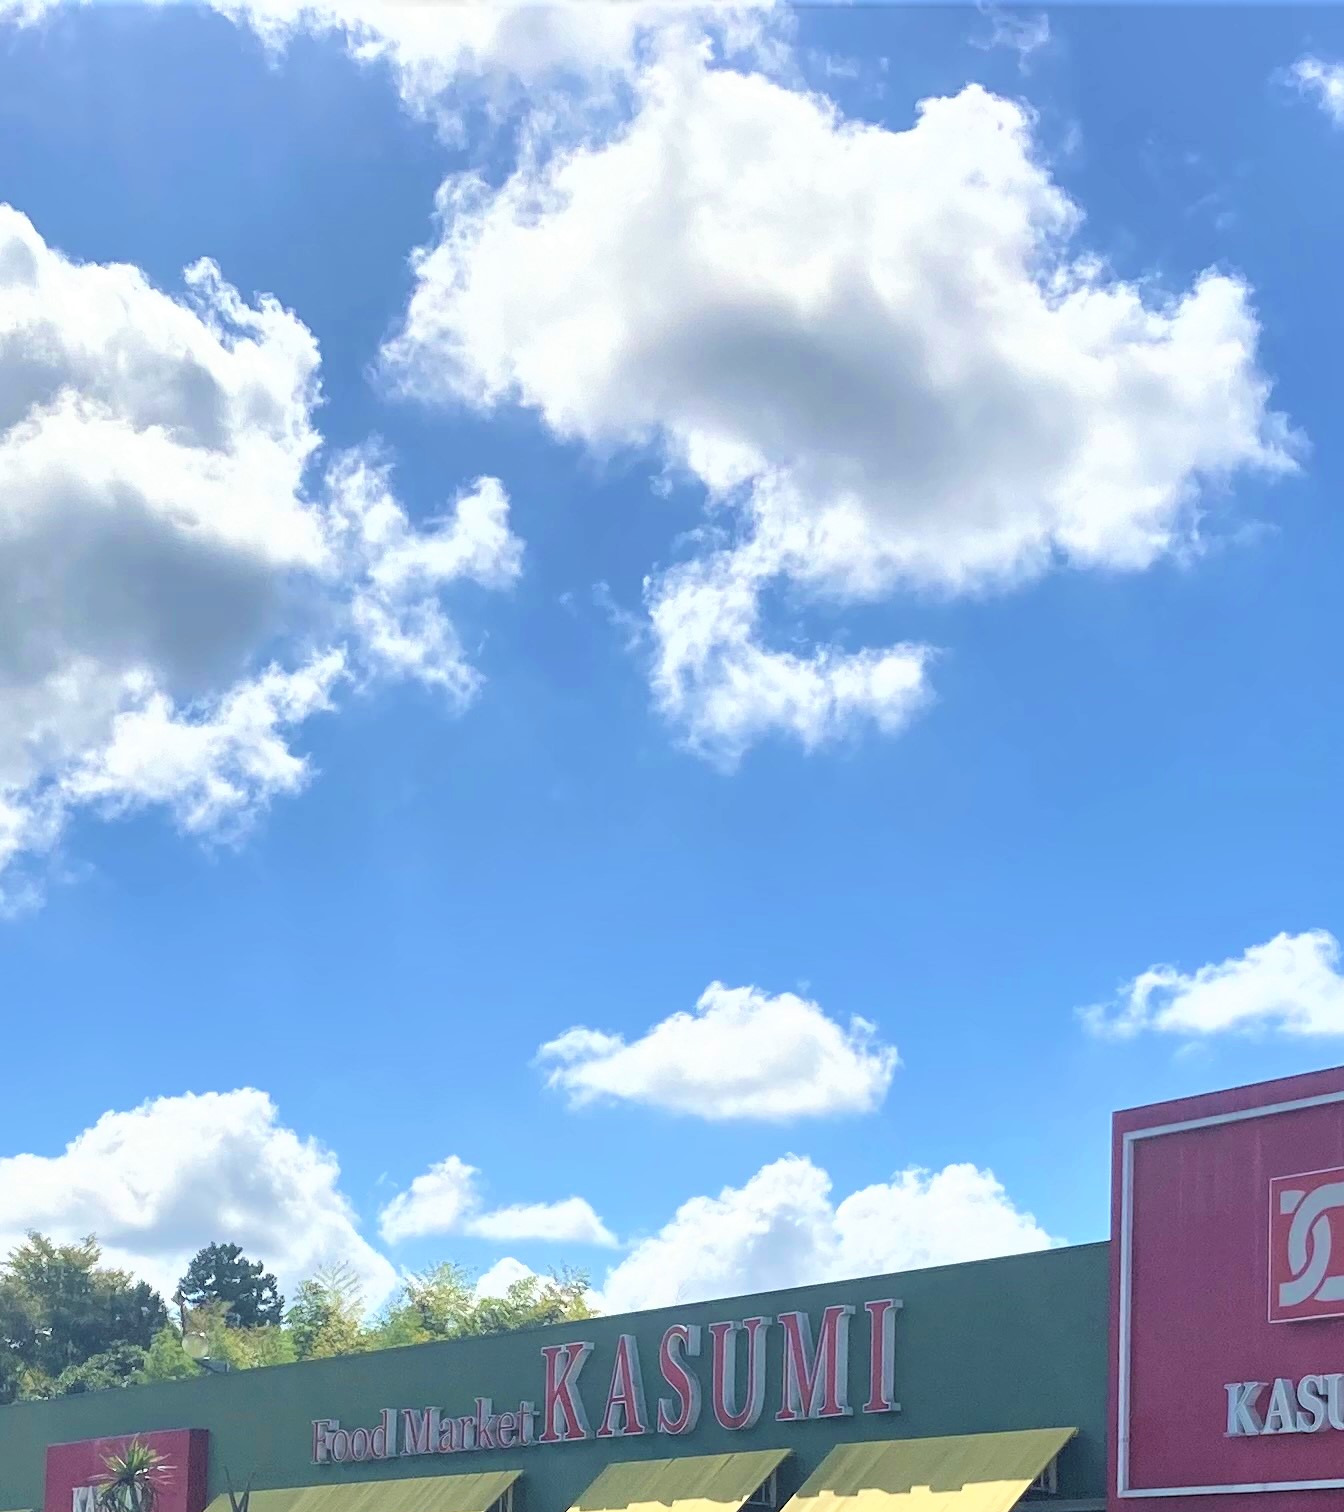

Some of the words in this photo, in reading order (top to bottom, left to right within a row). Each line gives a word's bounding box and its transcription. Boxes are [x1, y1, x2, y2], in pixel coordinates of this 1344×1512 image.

[310, 1408, 398, 1464] Food
[400, 1396, 537, 1455] Market
[540, 1299, 902, 1443] KASUMI
